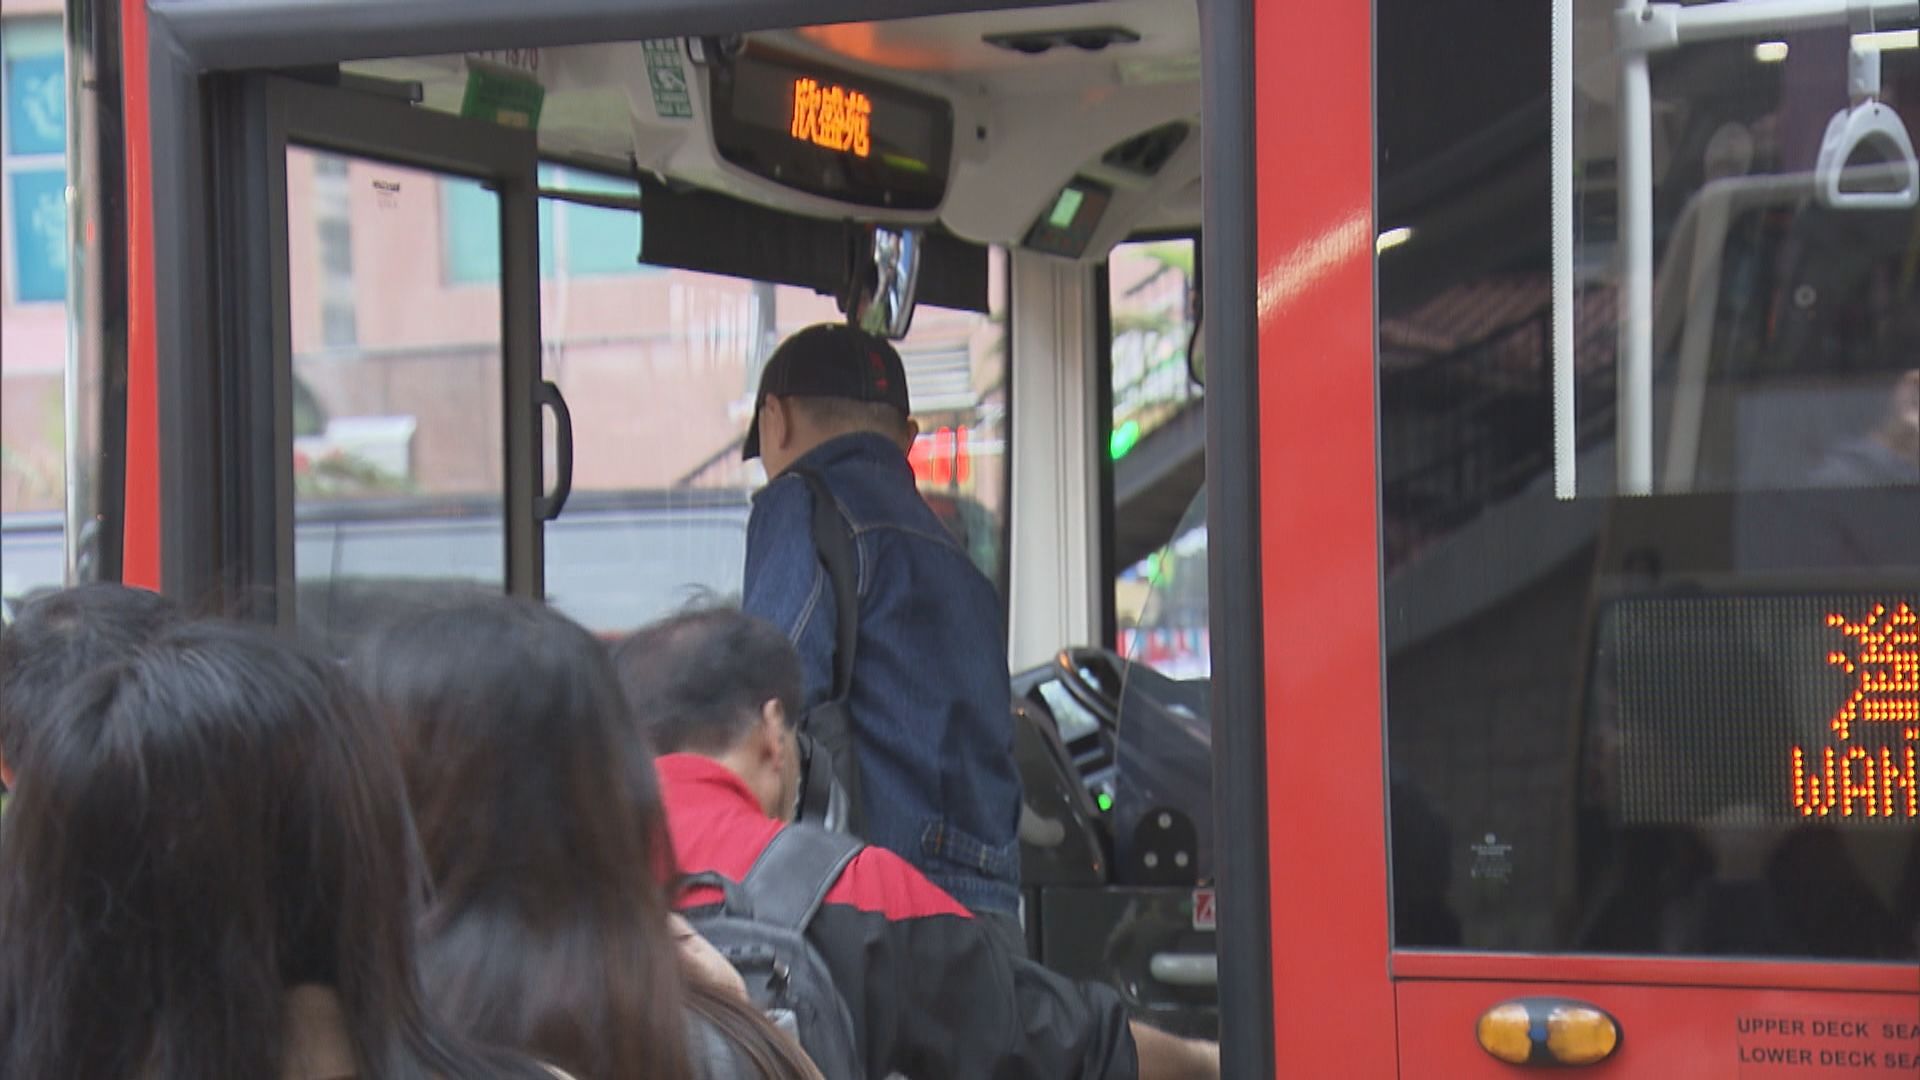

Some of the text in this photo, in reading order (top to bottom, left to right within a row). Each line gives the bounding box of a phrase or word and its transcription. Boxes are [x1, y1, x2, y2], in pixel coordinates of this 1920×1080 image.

[1792, 746, 1918, 816] WAN
[1737, 1018, 1805, 1036] UPPER
[1812, 1020, 1870, 1037] DECK
[1739, 1047, 1813, 1065] LOWER
[1820, 1050, 1877, 1067] DECK
